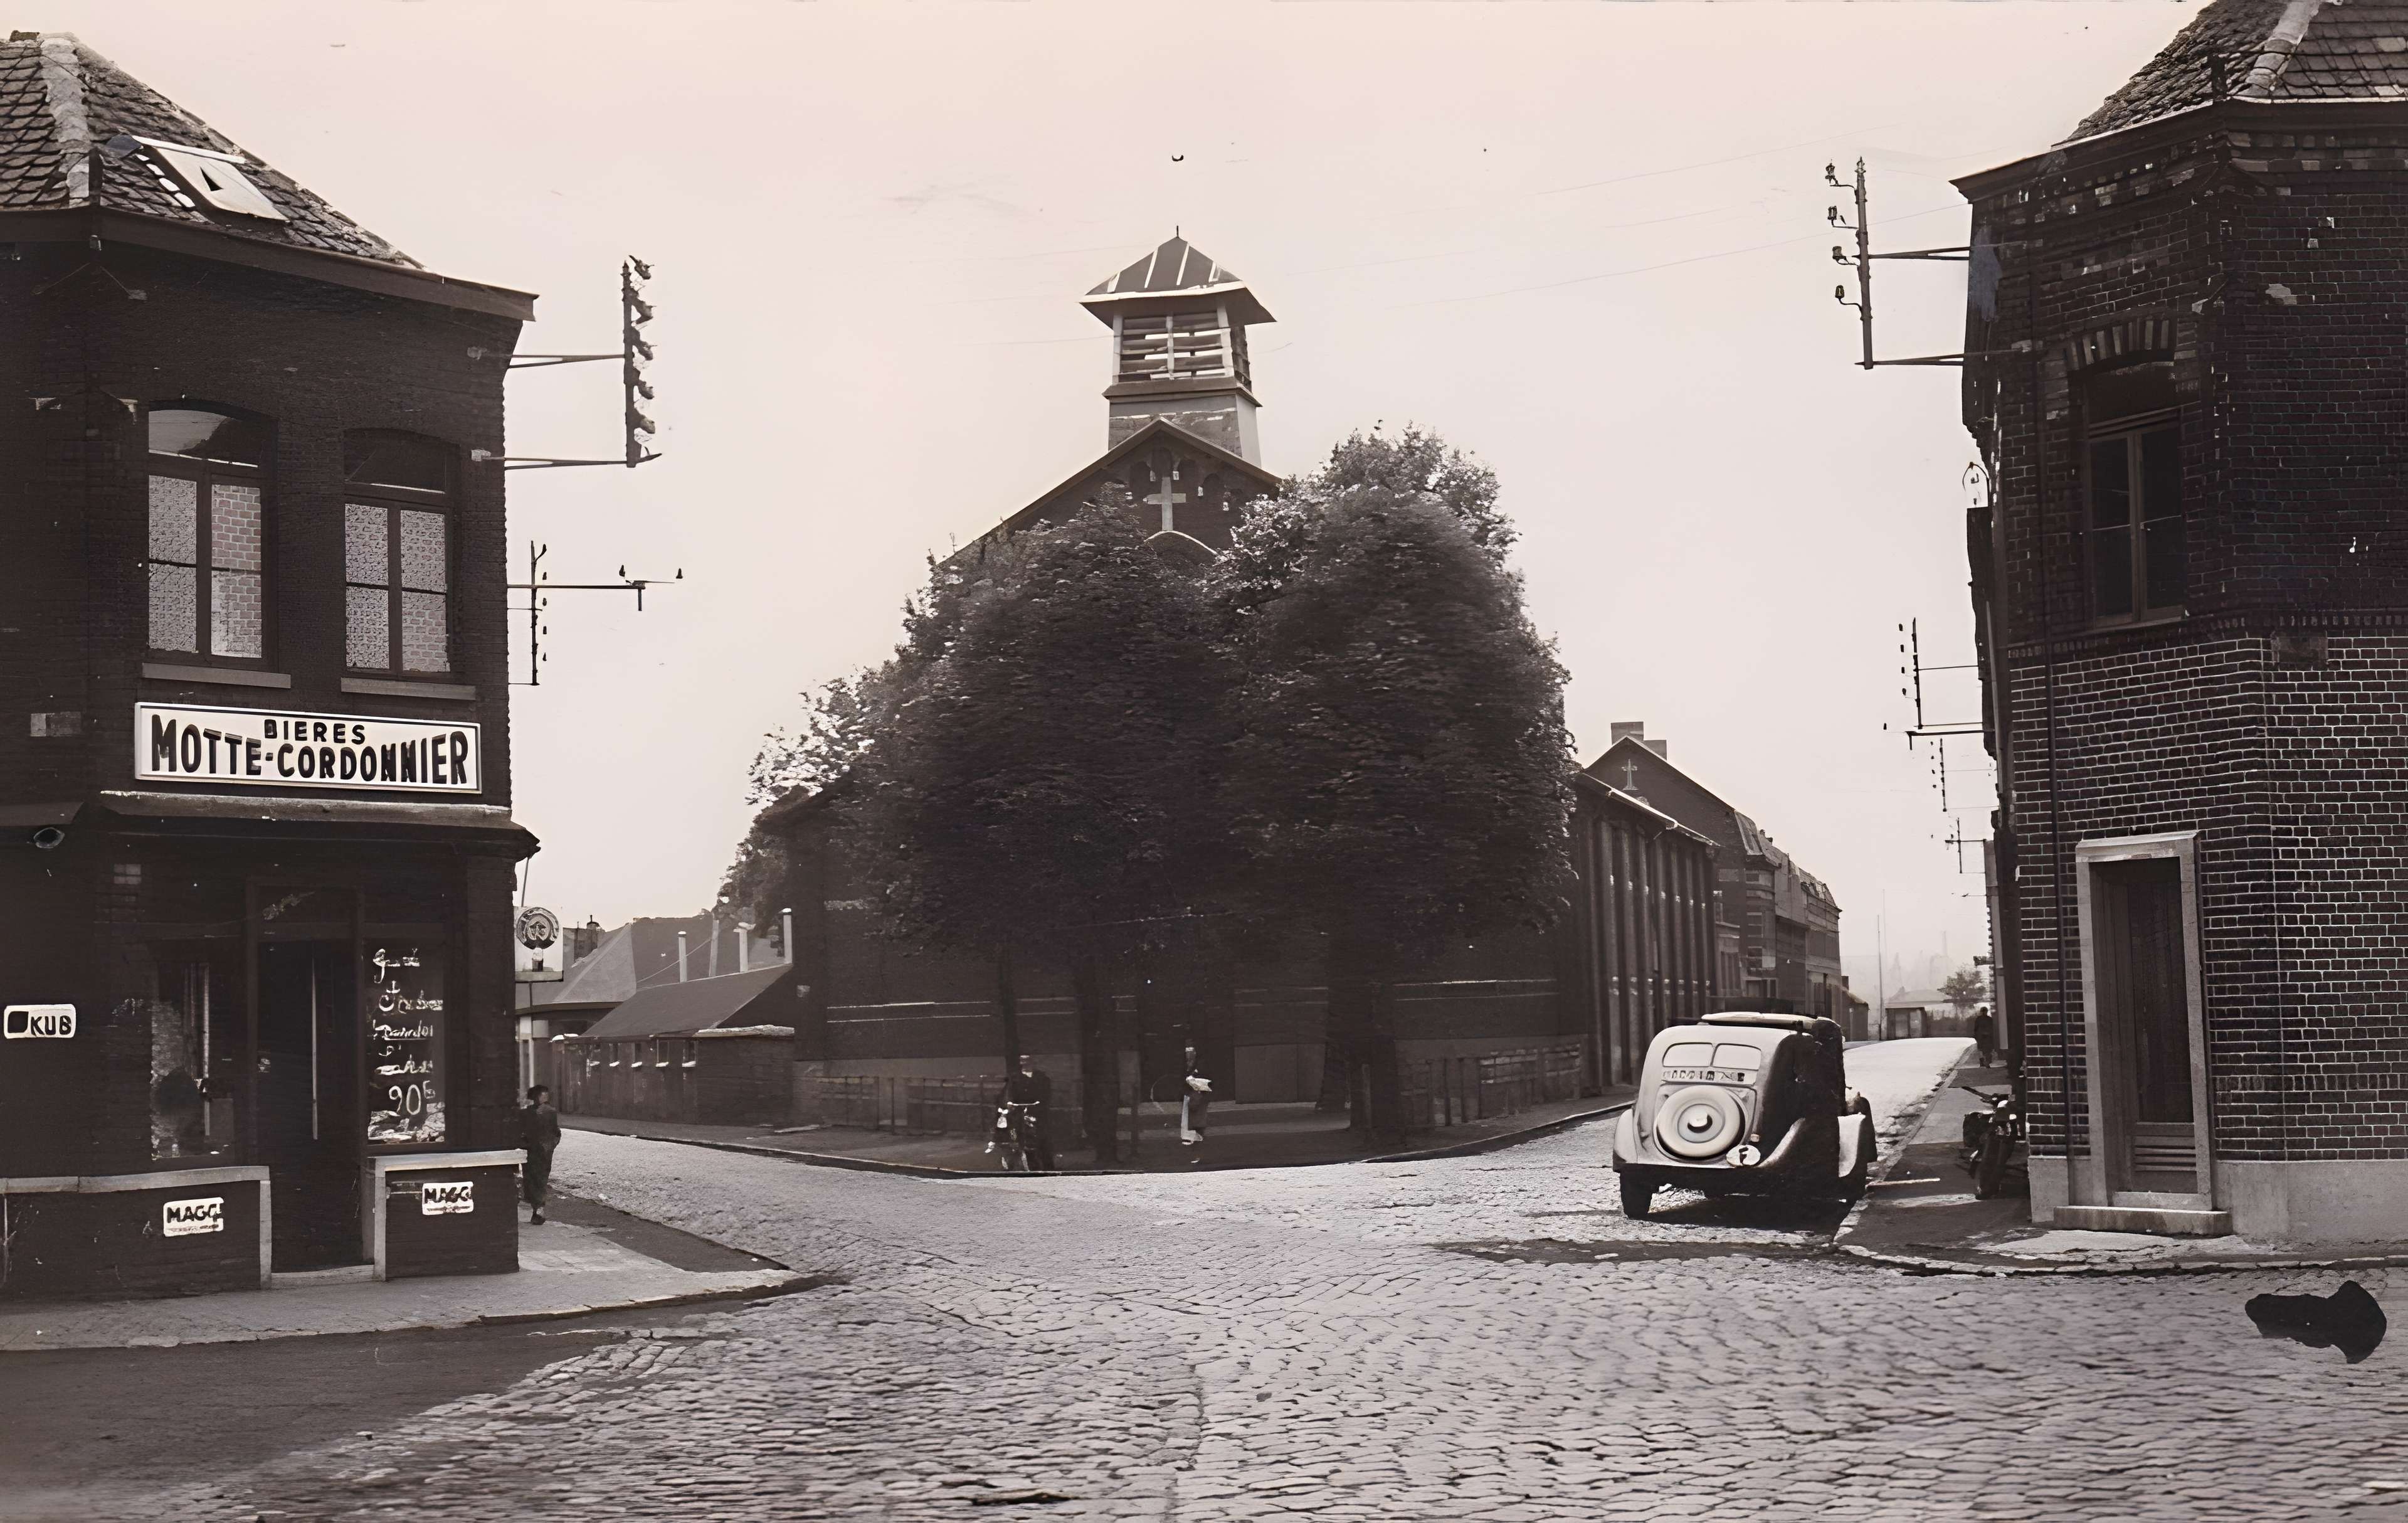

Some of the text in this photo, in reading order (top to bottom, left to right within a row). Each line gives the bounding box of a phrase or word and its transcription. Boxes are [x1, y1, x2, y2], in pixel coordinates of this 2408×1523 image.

[264, 719, 365, 745] BIERES
[151, 714, 468, 785] MOTTE-CORDONNIER
[30, 1015, 71, 1036] KUB
[1738, 1147, 1749, 1164] F
